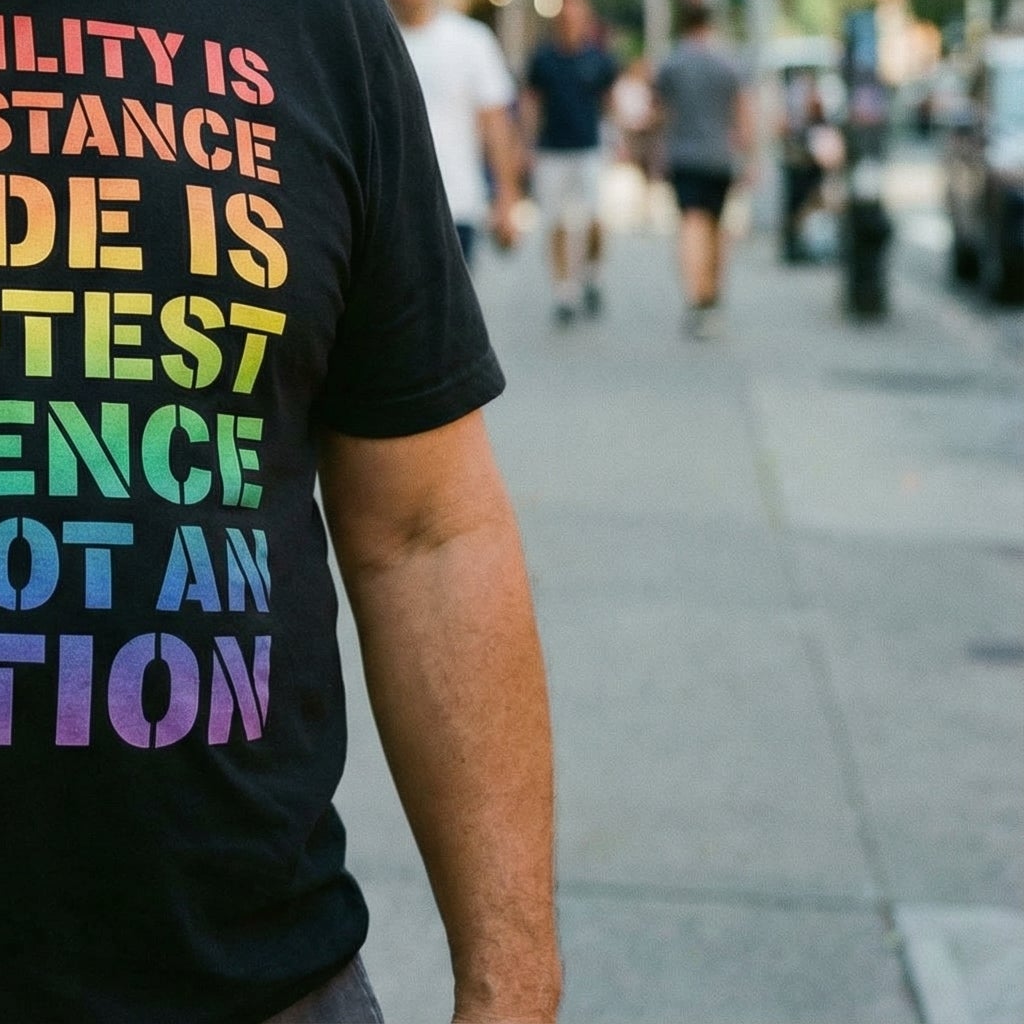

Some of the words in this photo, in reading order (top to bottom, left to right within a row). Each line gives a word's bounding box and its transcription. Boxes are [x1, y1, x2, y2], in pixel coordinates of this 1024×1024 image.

[204, 40, 276, 106] IS
[186, 185, 288, 289] IS
[156, 526, 272, 613] AN
